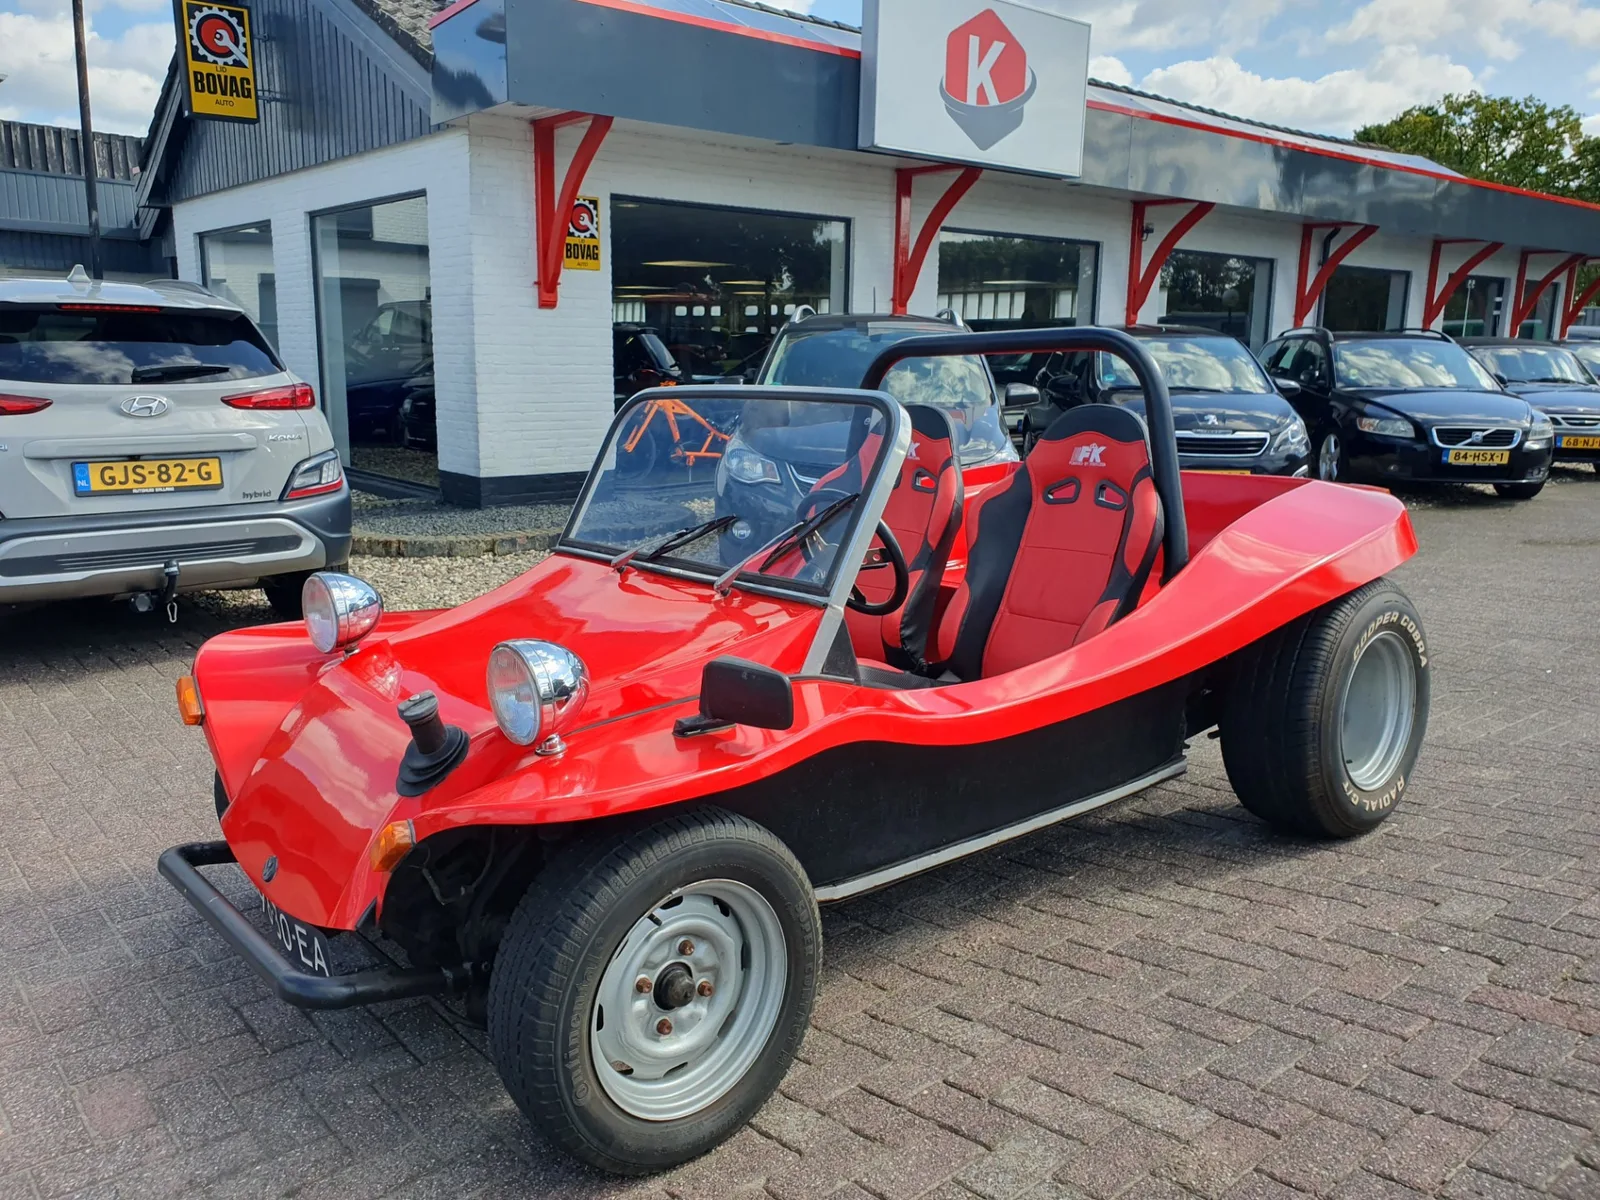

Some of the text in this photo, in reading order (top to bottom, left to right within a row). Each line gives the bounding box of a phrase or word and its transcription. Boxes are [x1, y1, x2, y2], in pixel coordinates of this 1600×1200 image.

[215, 65, 227, 73] LID
[967, 34, 1006, 106] K
[193, 70, 253, 99] BOVAG
[215, 98, 235, 107] AUTO
[566, 243, 599, 260] BOVAG
[268, 433, 303, 442] KONA
[1454, 451, 1505, 462] 84-HSX-1
[100, 461, 212, 486] GJS-82-G
[242, 489, 272, 499] hybrid
[1353, 611, 1428, 668] COOPER COBRA
[1363, 775, 1405, 811] RADIAL
